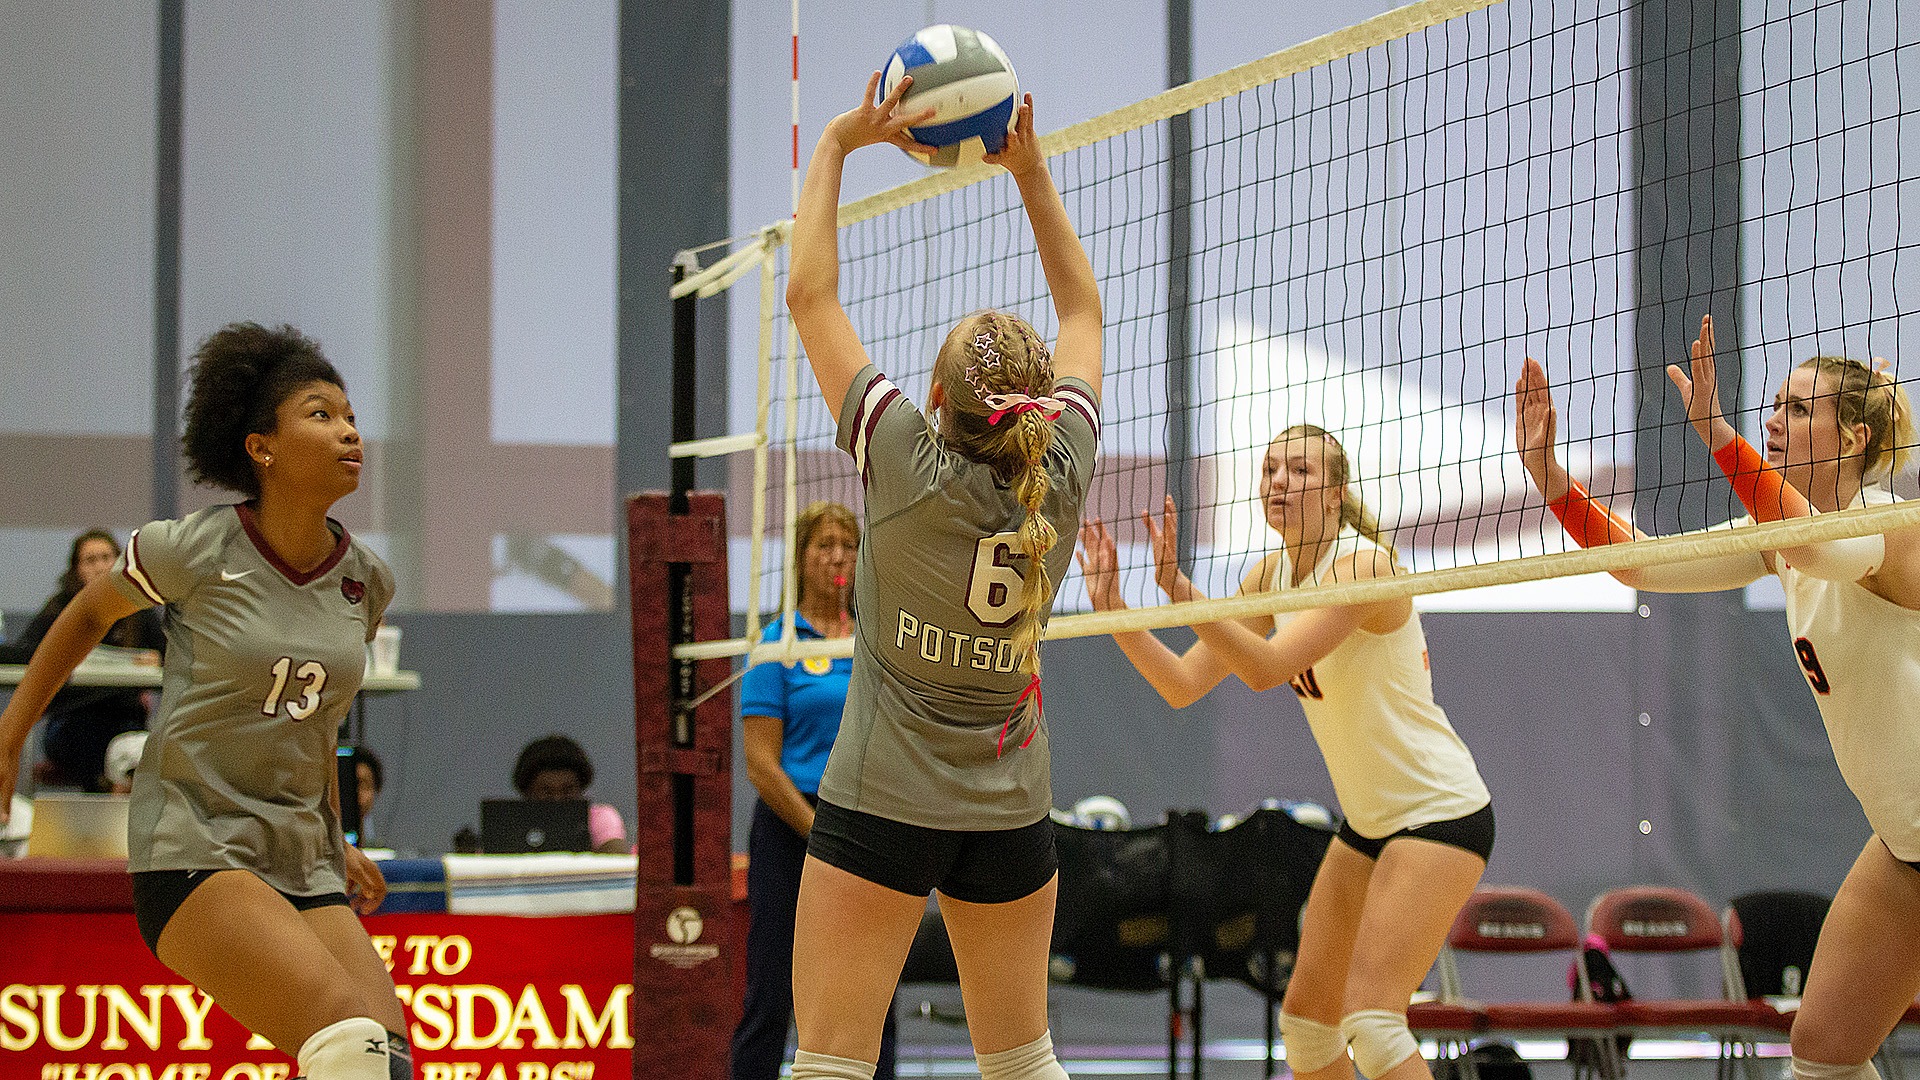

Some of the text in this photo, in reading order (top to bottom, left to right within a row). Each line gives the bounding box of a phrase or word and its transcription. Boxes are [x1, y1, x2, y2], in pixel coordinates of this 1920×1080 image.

[964, 531, 1028, 628] 6
[894, 607, 1025, 674] POTSD
[1794, 636, 1831, 696] 9
[261, 656, 328, 721] 13
[404, 934, 472, 975] TO
[0, 983, 215, 1051] SUNY
